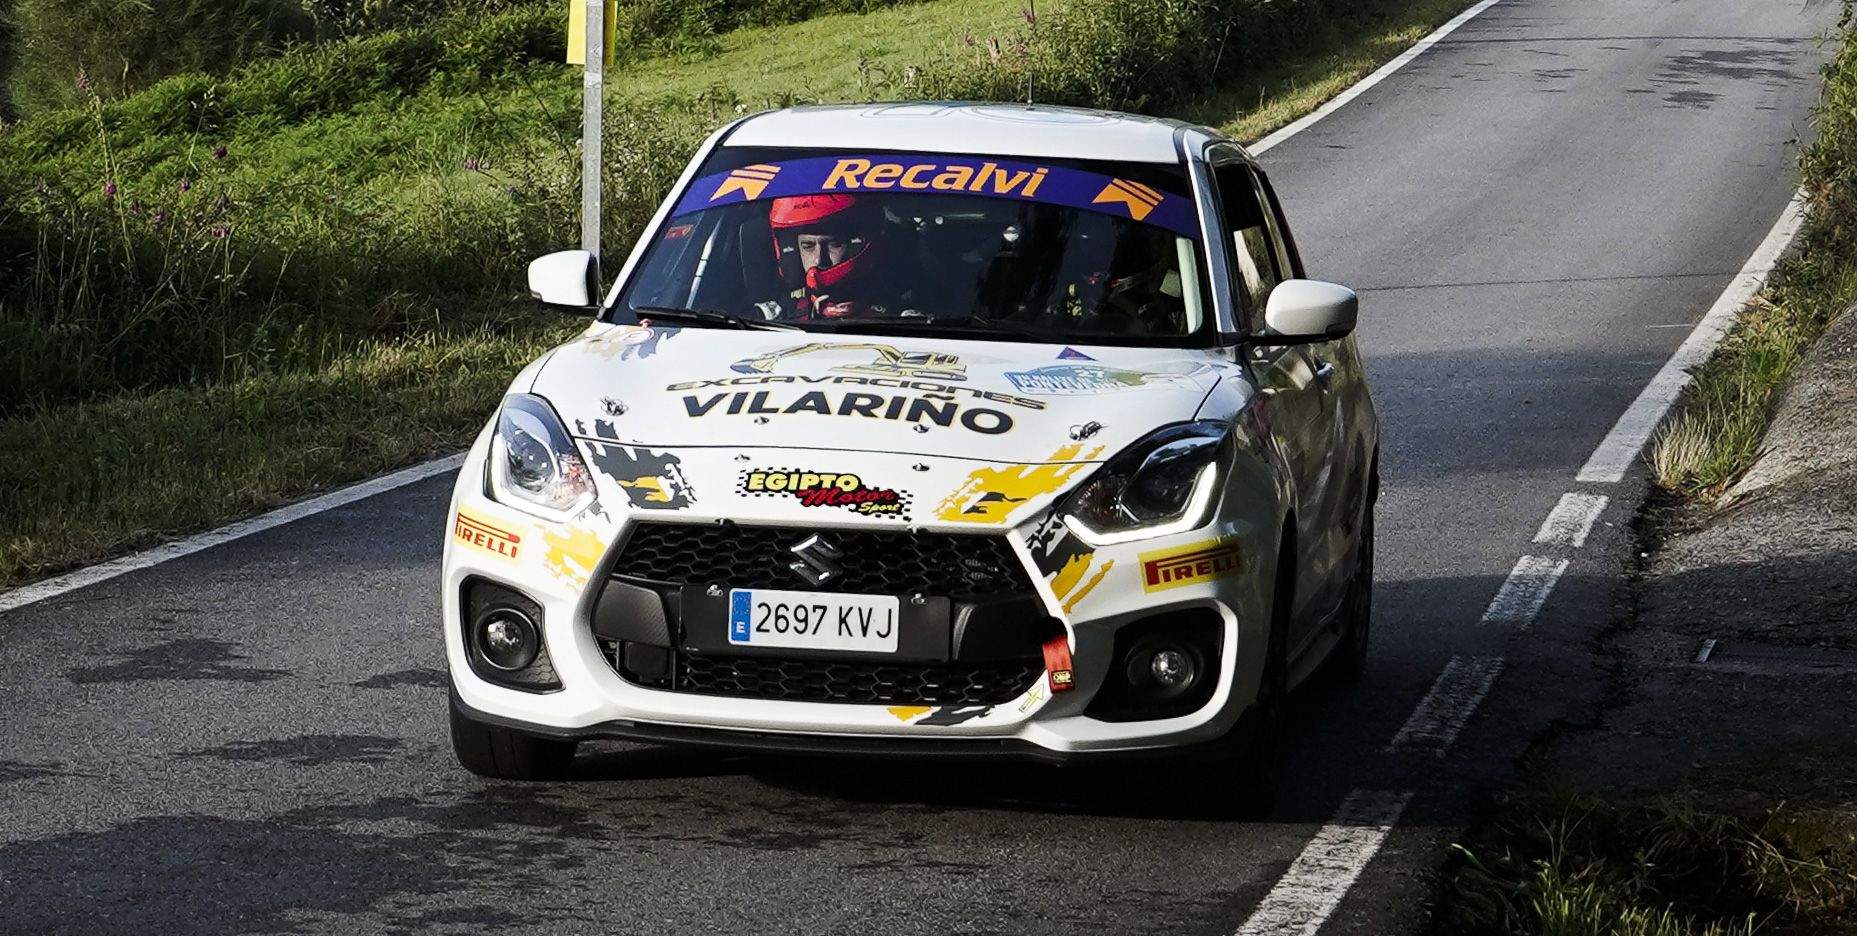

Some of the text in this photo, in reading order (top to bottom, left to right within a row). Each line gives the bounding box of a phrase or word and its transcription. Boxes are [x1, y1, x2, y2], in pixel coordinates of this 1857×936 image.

[822, 158, 1049, 198] Recalvi
[666, 375, 1046, 411] EXCAVACIONES
[684, 390, 1014, 435] VILARIÑO
[747, 472, 860, 492] EGIPTO
[796, 486, 899, 506] Motor
[858, 501, 900, 514] Sport
[1144, 543, 1242, 586] PIRELLI
[736, 621, 746, 634] E
[755, 602, 892, 638] 2697 KVJ
